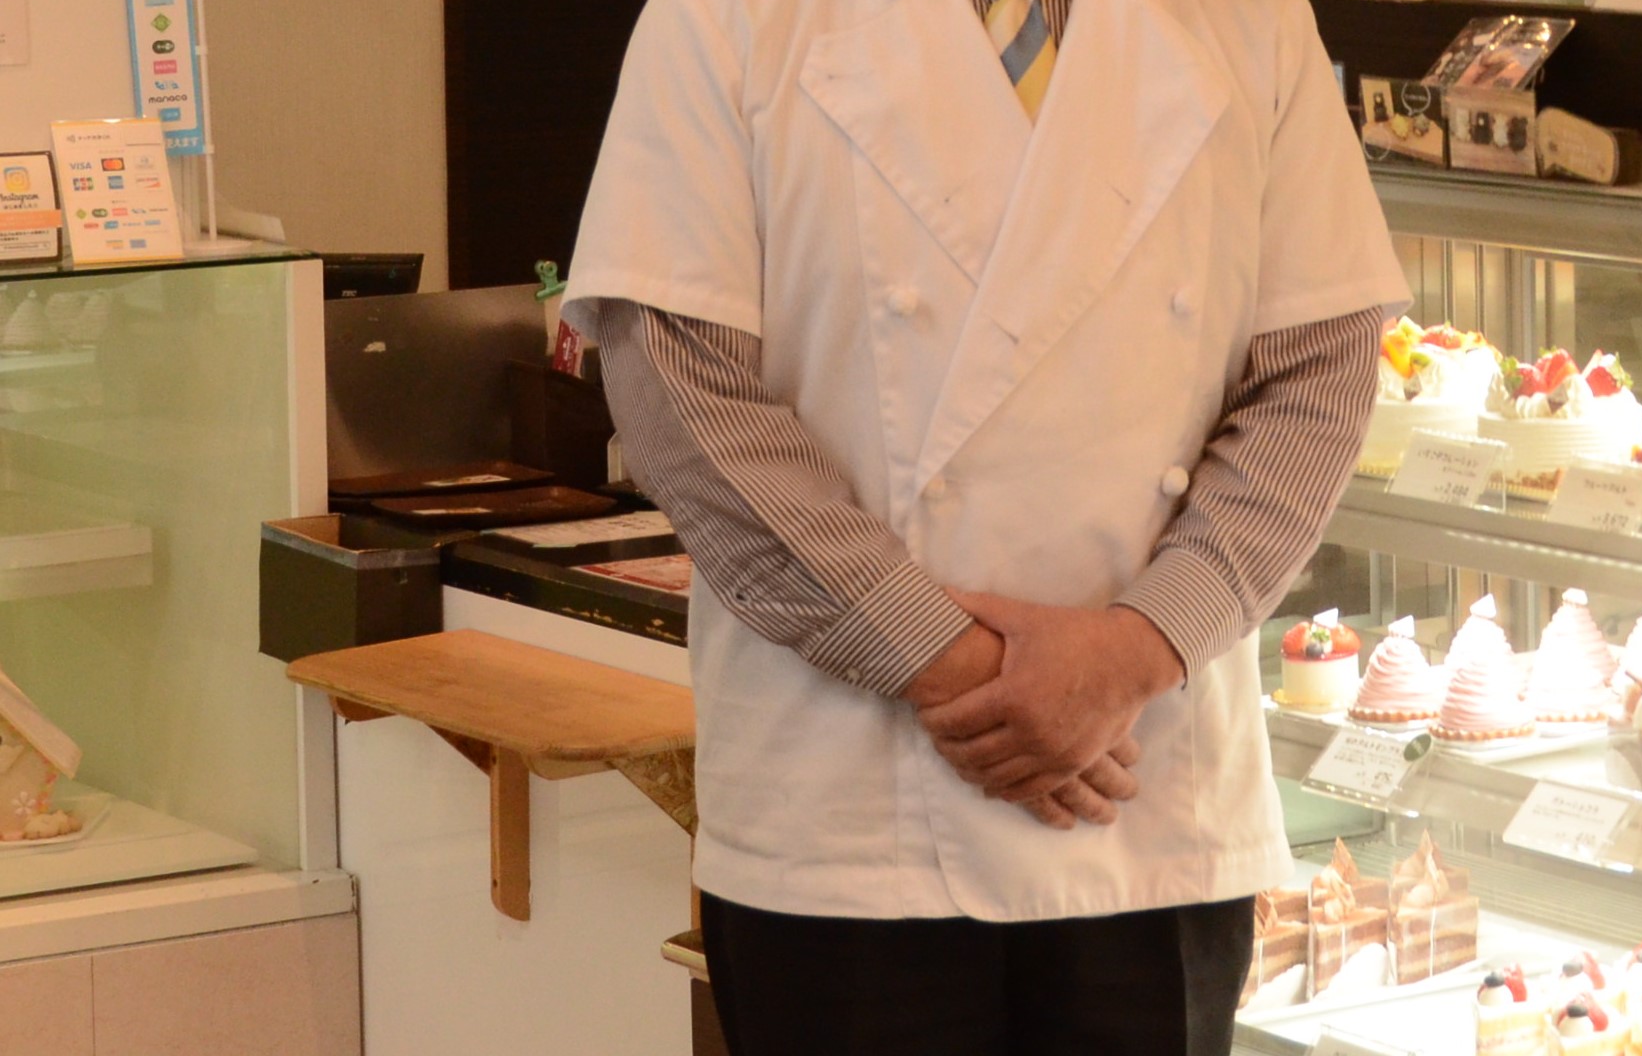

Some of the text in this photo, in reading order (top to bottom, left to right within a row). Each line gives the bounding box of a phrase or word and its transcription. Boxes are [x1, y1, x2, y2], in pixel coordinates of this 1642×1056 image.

[148, 94, 188, 104] manaca
[165, 137, 199, 148] えます
[70, 161, 93, 170] VISA
